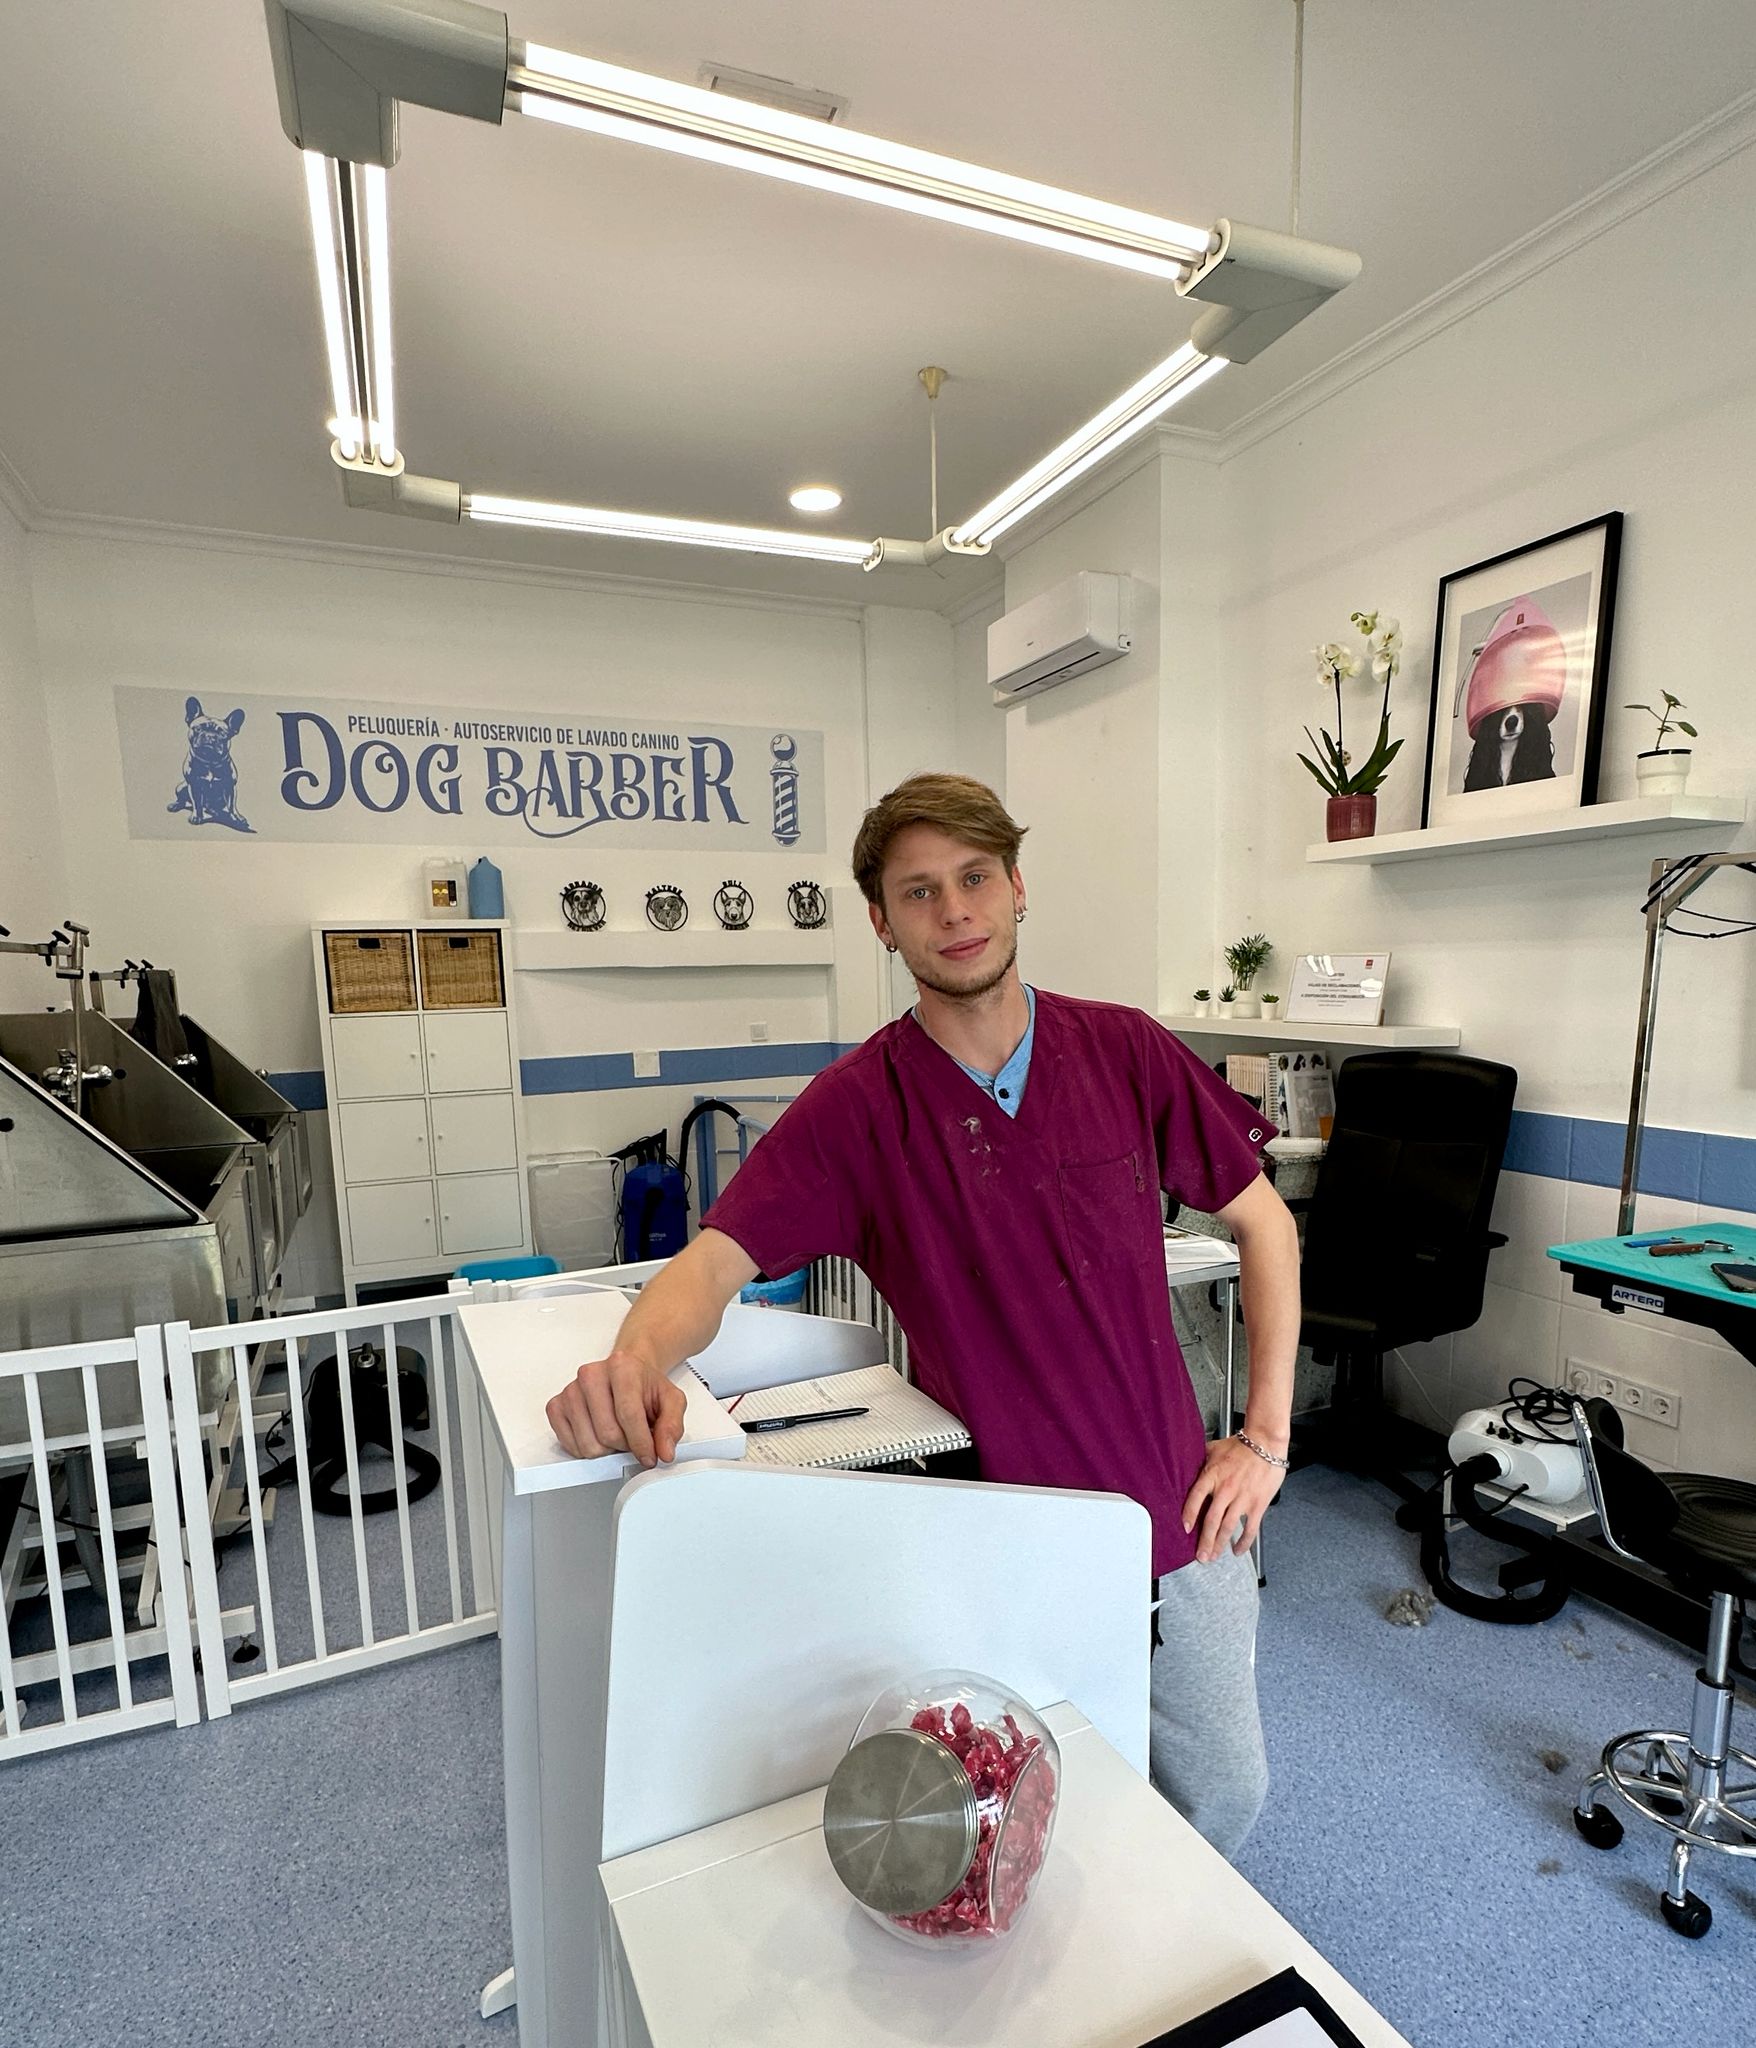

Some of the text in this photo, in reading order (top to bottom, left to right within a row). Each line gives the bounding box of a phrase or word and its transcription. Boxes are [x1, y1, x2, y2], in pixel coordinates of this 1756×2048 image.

[348, 715, 440, 737] PELUQUERÍA
[454, 722, 550, 743] AUTOSERVICIO
[556, 728, 573, 745] DE
[578, 729, 627, 747] LAVADO
[632, 732, 679, 750] CANINO
[276, 712, 750, 838] DOG BARBER
[1613, 1289, 1664, 1308] ARTERO
